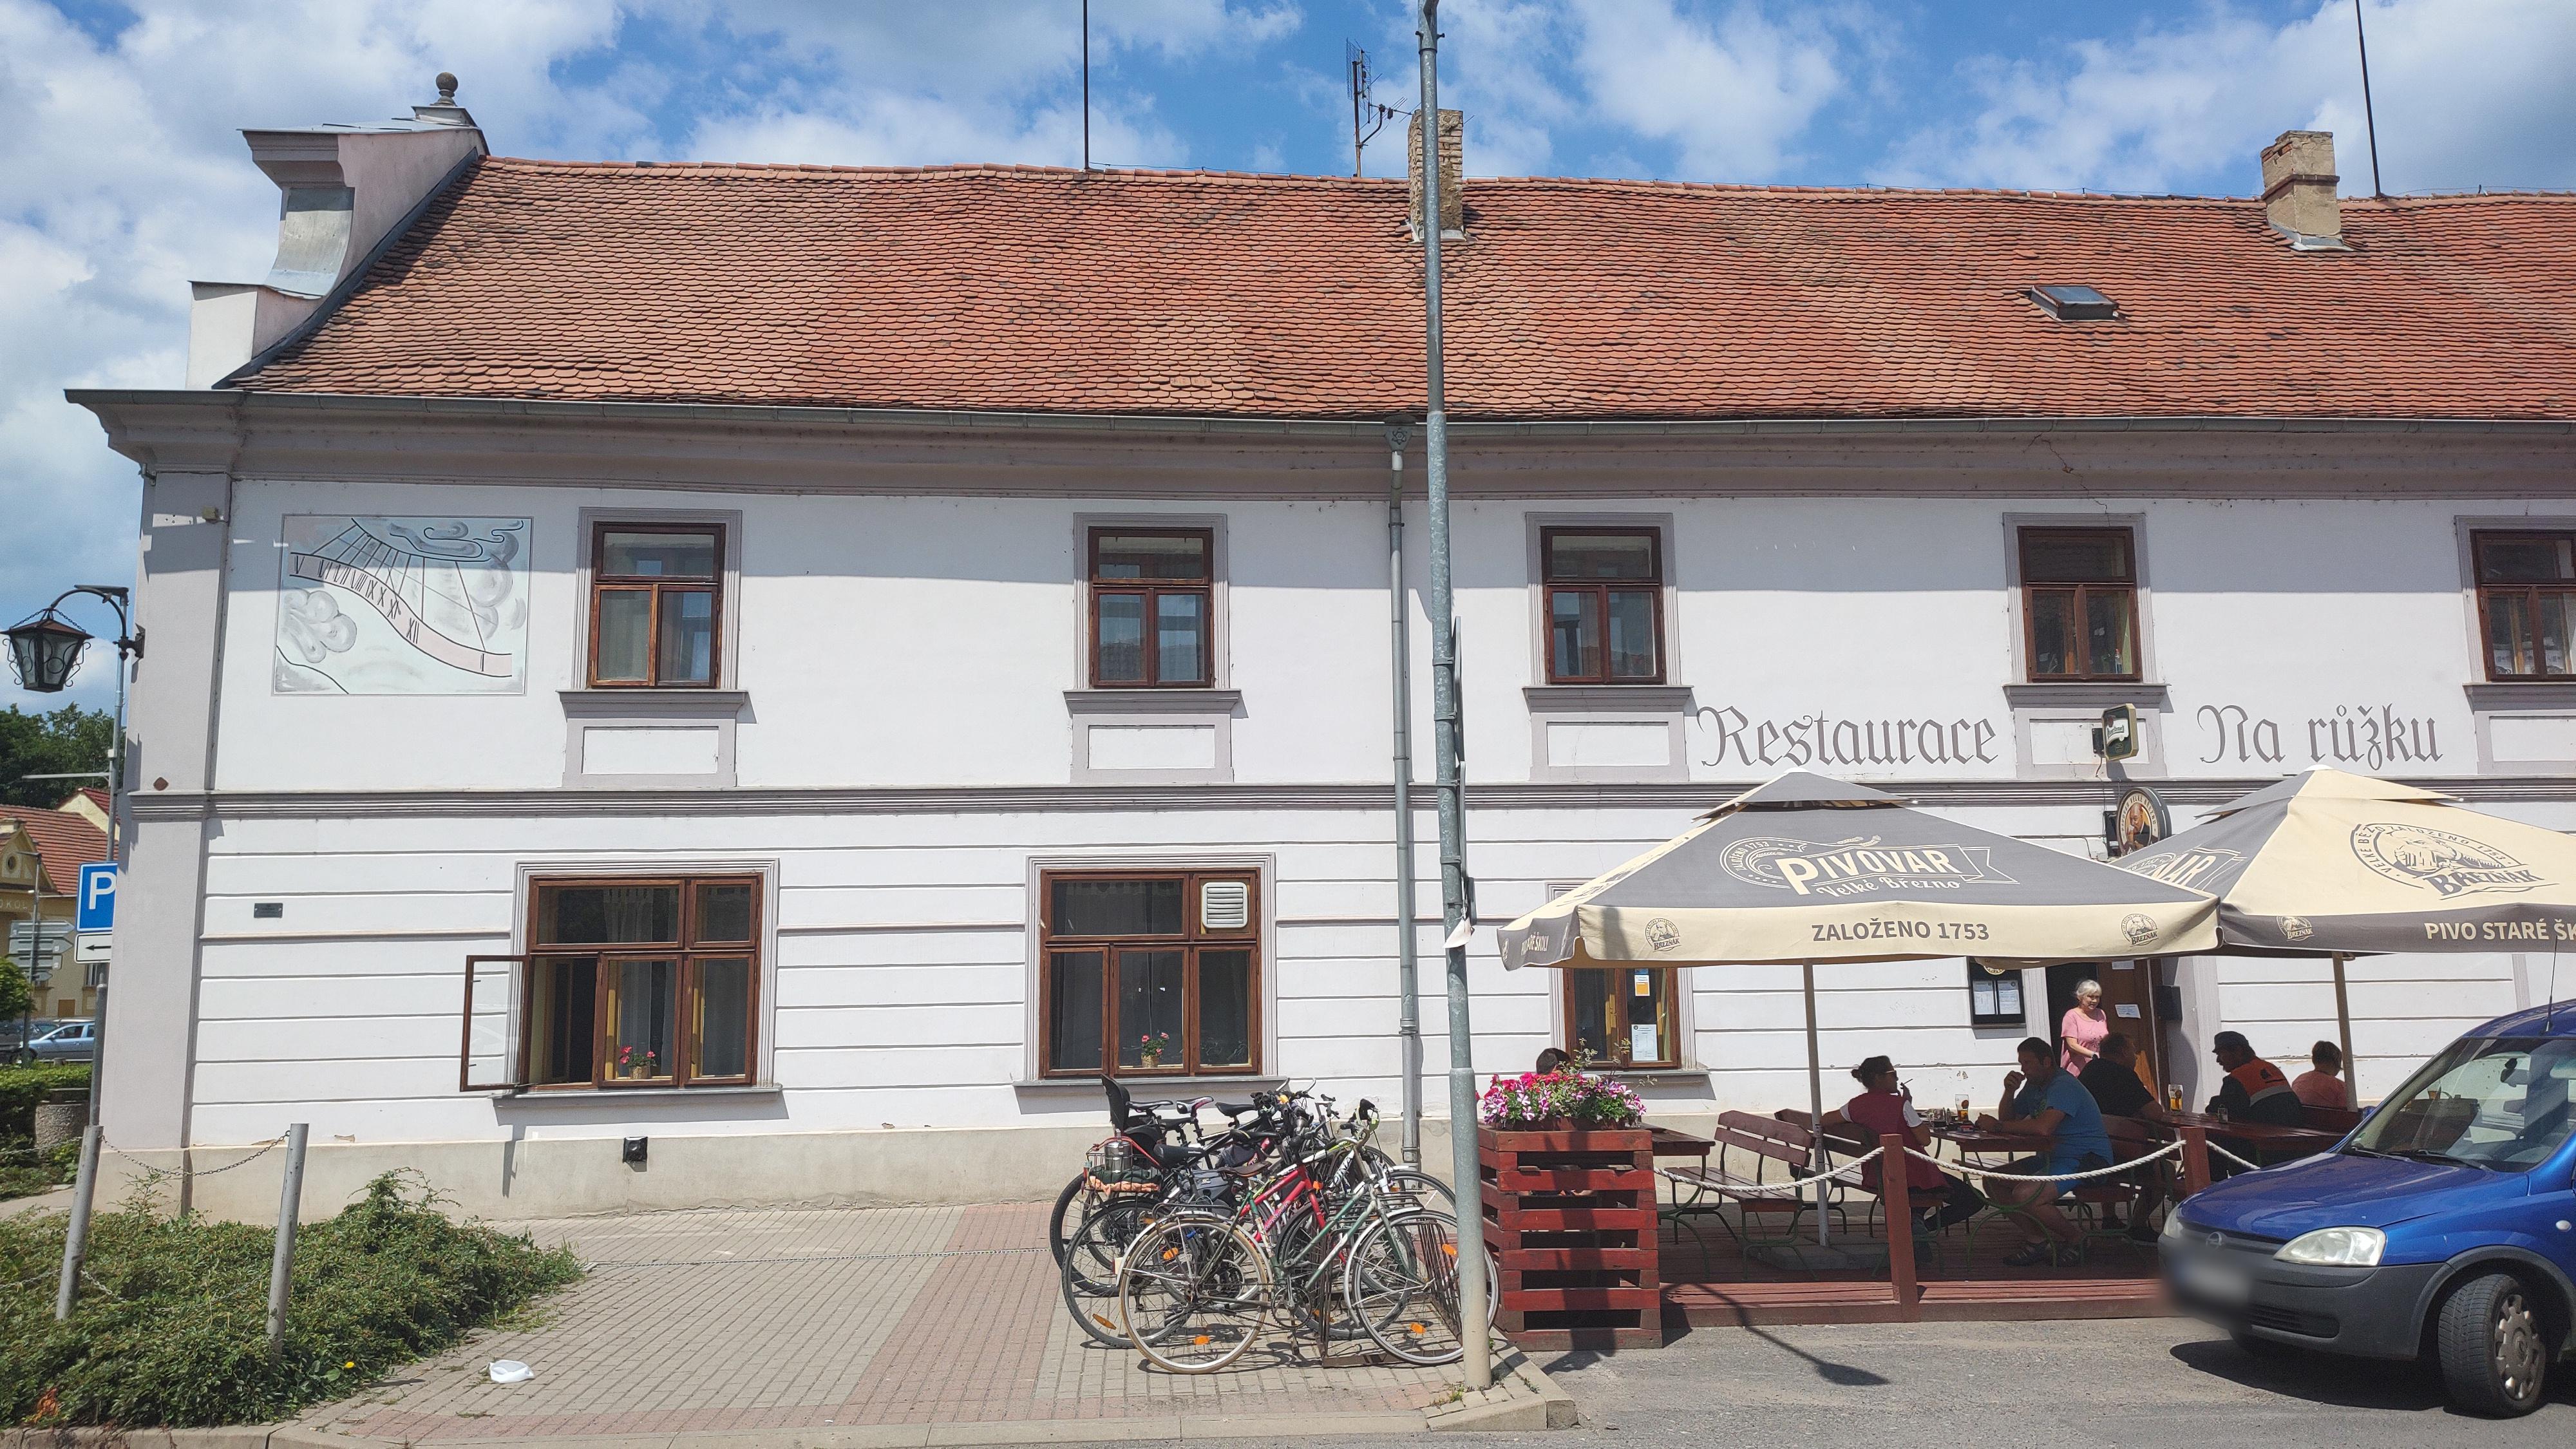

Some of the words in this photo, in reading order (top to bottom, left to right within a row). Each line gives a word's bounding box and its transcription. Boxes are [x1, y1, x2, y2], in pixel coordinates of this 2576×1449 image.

[377, 587, 386, 607] X
[406, 618, 419, 645] XII
[1696, 705, 1998, 766] Restaurace
[2197, 705, 2286, 763] Na
[2307, 703, 2443, 770] růžku
[1775, 849, 1962, 895] PIVOVAR
[2477, 846, 2506, 860] 1753
[88, 871, 117, 911] P
[1815, 880, 1879, 897] Velké
[1879, 876, 1960, 889] Březno
[1812, 918, 1931, 942] ZALOŽENO
[1937, 922, 1989, 940] 1753
[2424, 922, 2477, 940] PIVO
[2483, 918, 2550, 940] STARÉ
